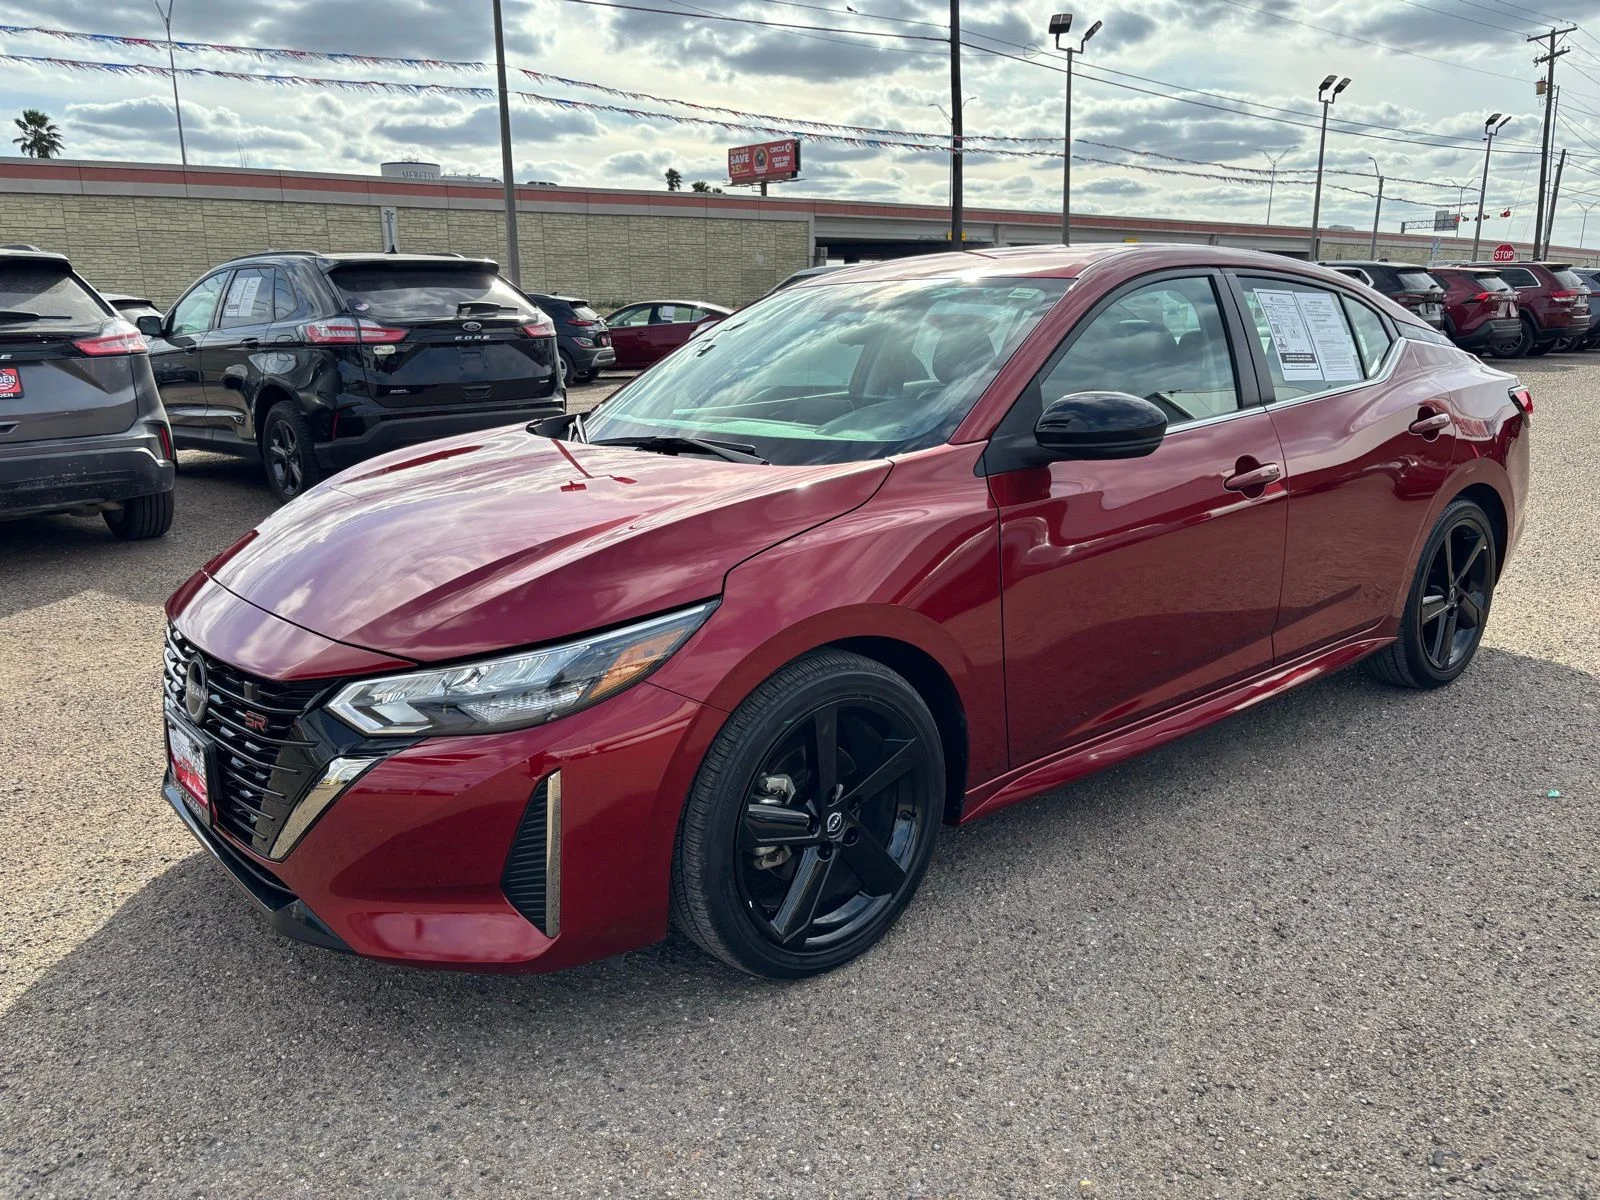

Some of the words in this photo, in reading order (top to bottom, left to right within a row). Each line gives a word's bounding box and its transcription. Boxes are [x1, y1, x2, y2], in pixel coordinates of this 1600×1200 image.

[730, 154, 750, 164] SAVE
[1494, 250, 1514, 260] STOP
[245, 710, 267, 732] SR
